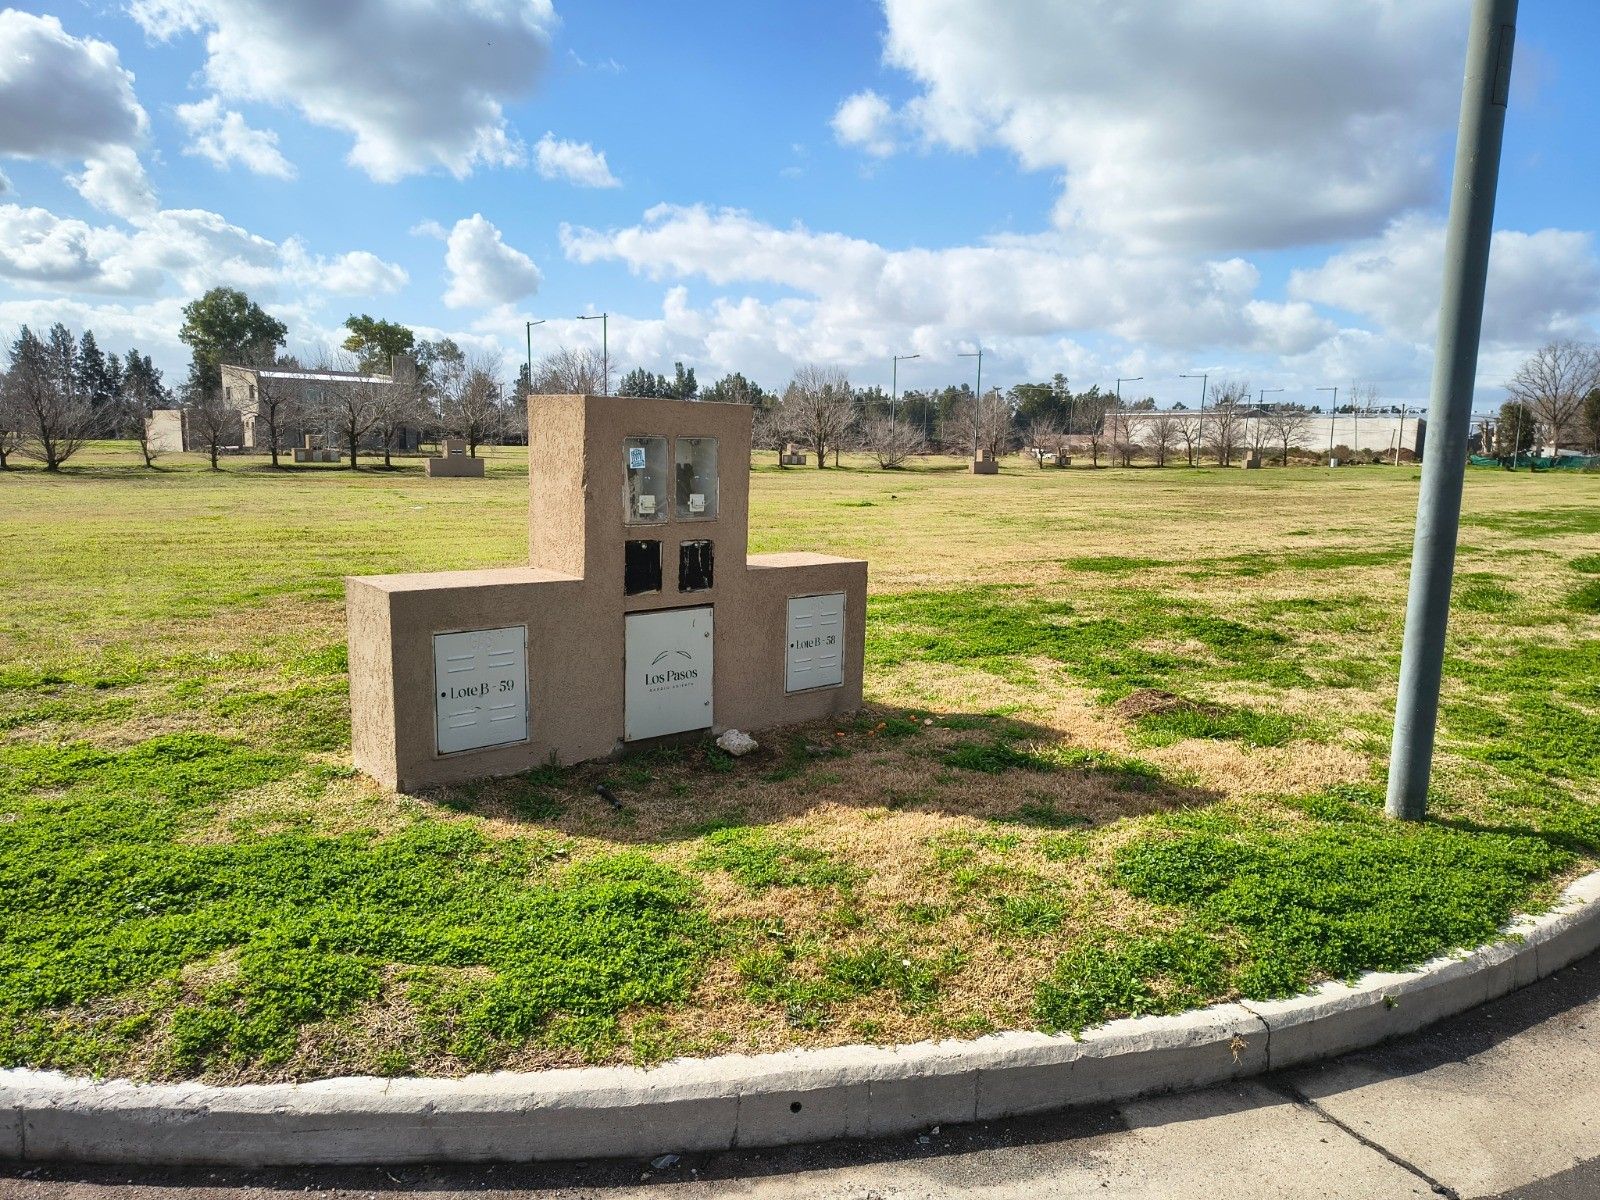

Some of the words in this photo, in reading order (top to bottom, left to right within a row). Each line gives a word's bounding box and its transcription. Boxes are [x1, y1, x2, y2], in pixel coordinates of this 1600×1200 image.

[796, 639, 814, 650] Lote
[814, 637, 821, 647] B
[826, 635, 836, 645] 58
[645, 673, 665, 686] Los
[667, 669, 698, 682] Pasos
[450, 687, 478, 699] Lote
[479, 682, 490, 696] B
[499, 679, 515, 692] 59
